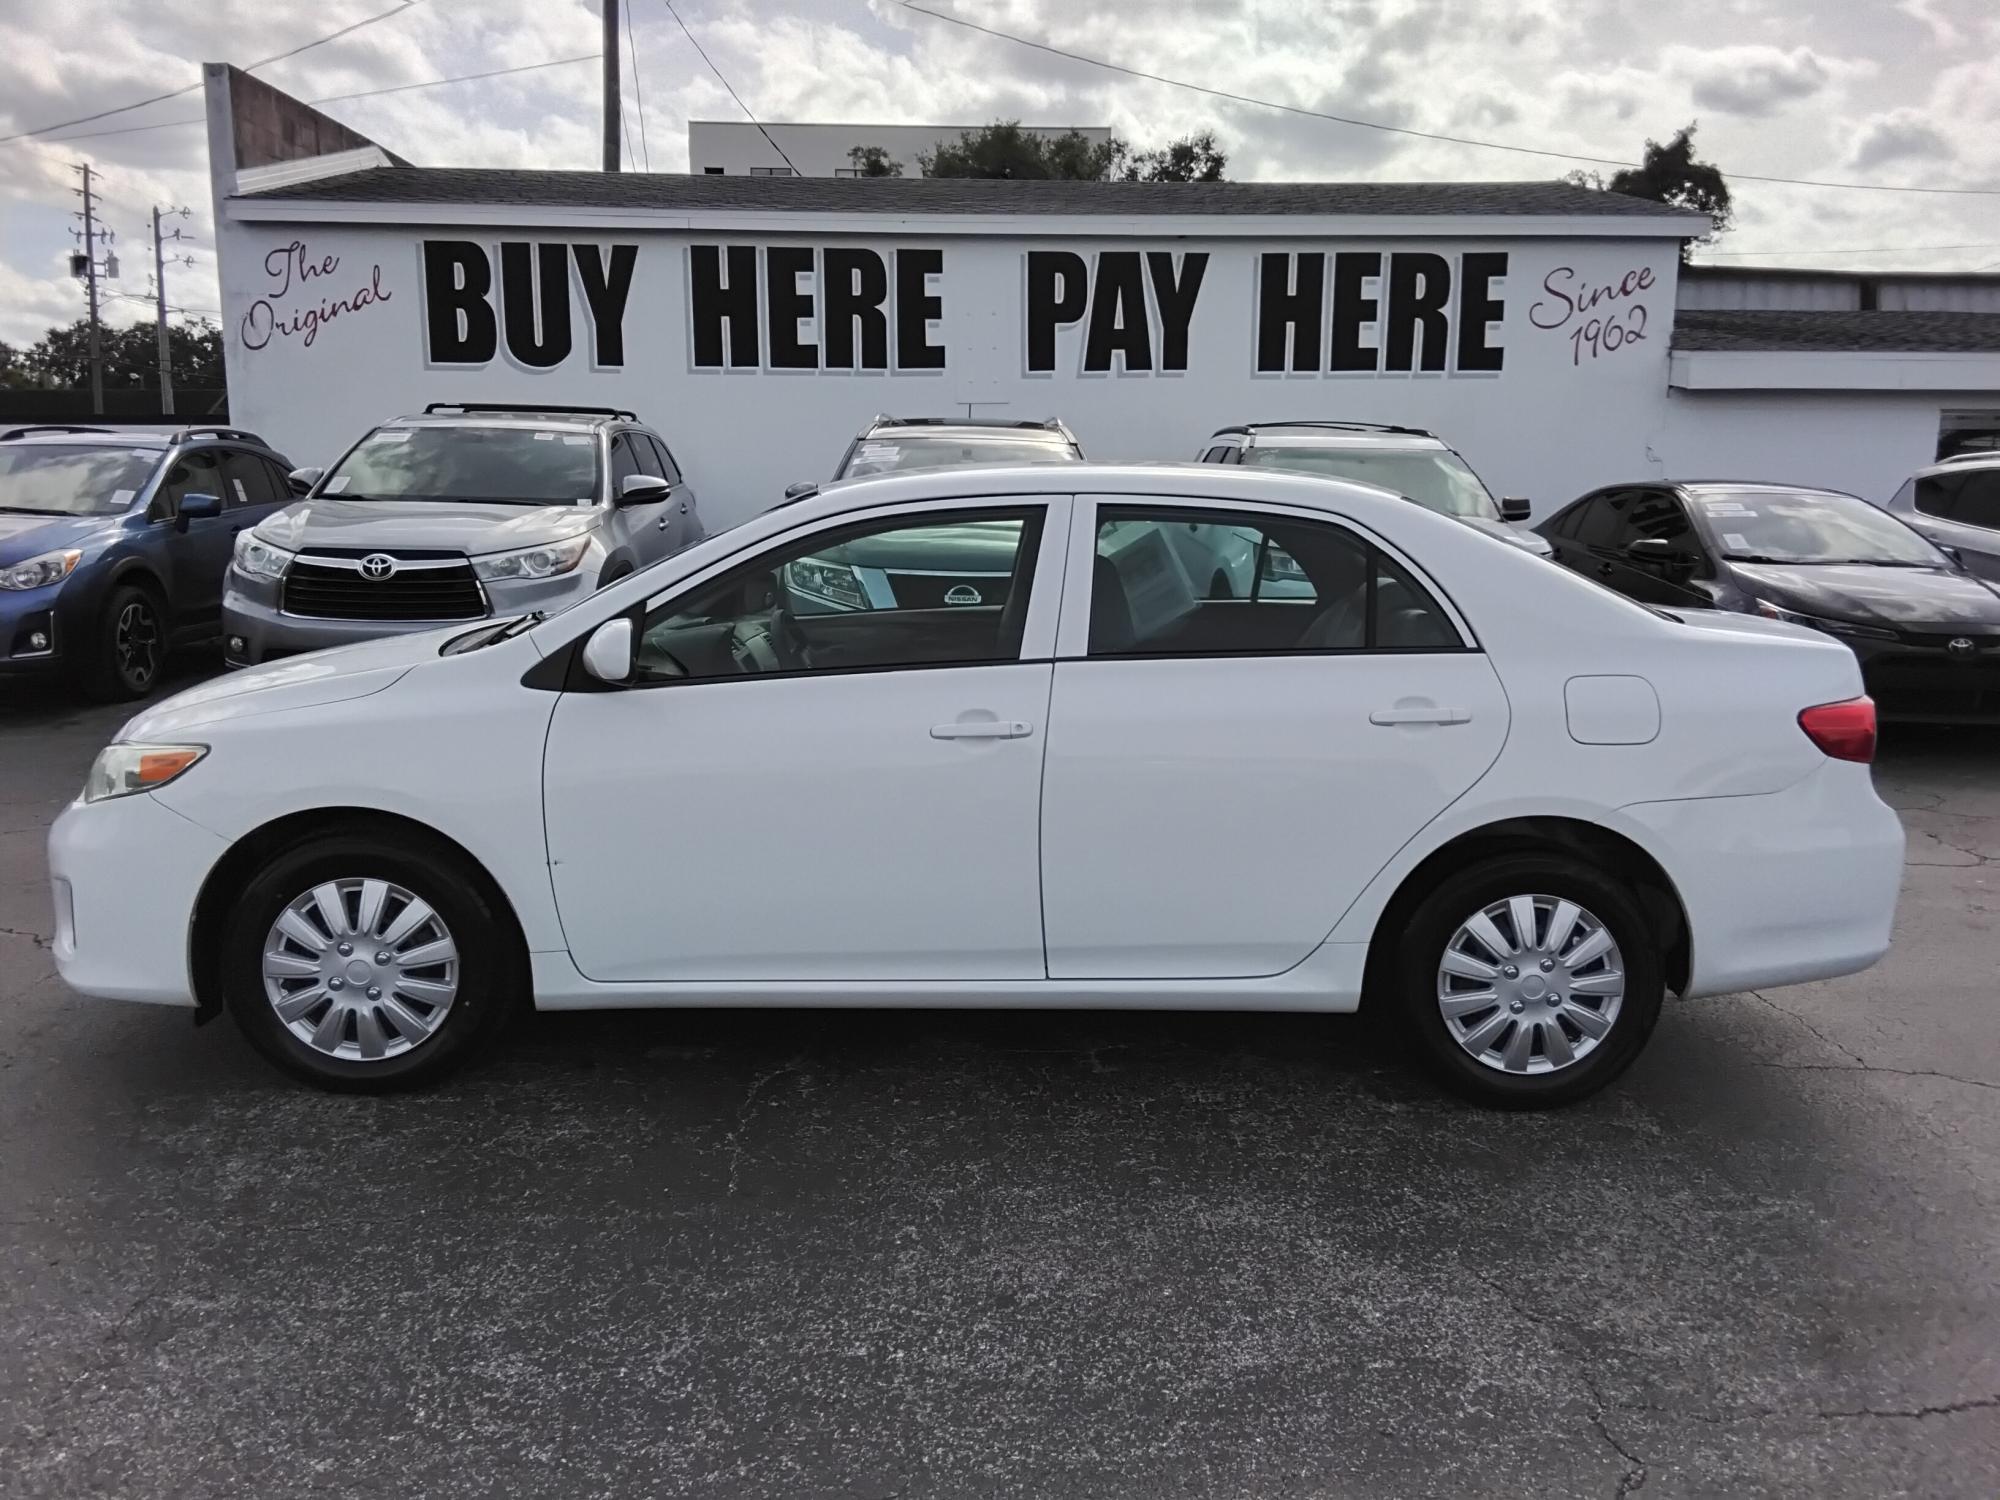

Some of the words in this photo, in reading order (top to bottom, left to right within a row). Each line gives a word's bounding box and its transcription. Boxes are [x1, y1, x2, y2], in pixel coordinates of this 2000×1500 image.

[265, 240, 340, 298] The
[1529, 266, 1656, 329] Since
[241, 264, 392, 350] Original
[423, 240, 639, 371] BUY
[690, 245, 945, 369] HERE
[1028, 251, 1210, 371] PAY
[1257, 252, 1508, 371] HERE
[1569, 304, 1647, 366] 1962
